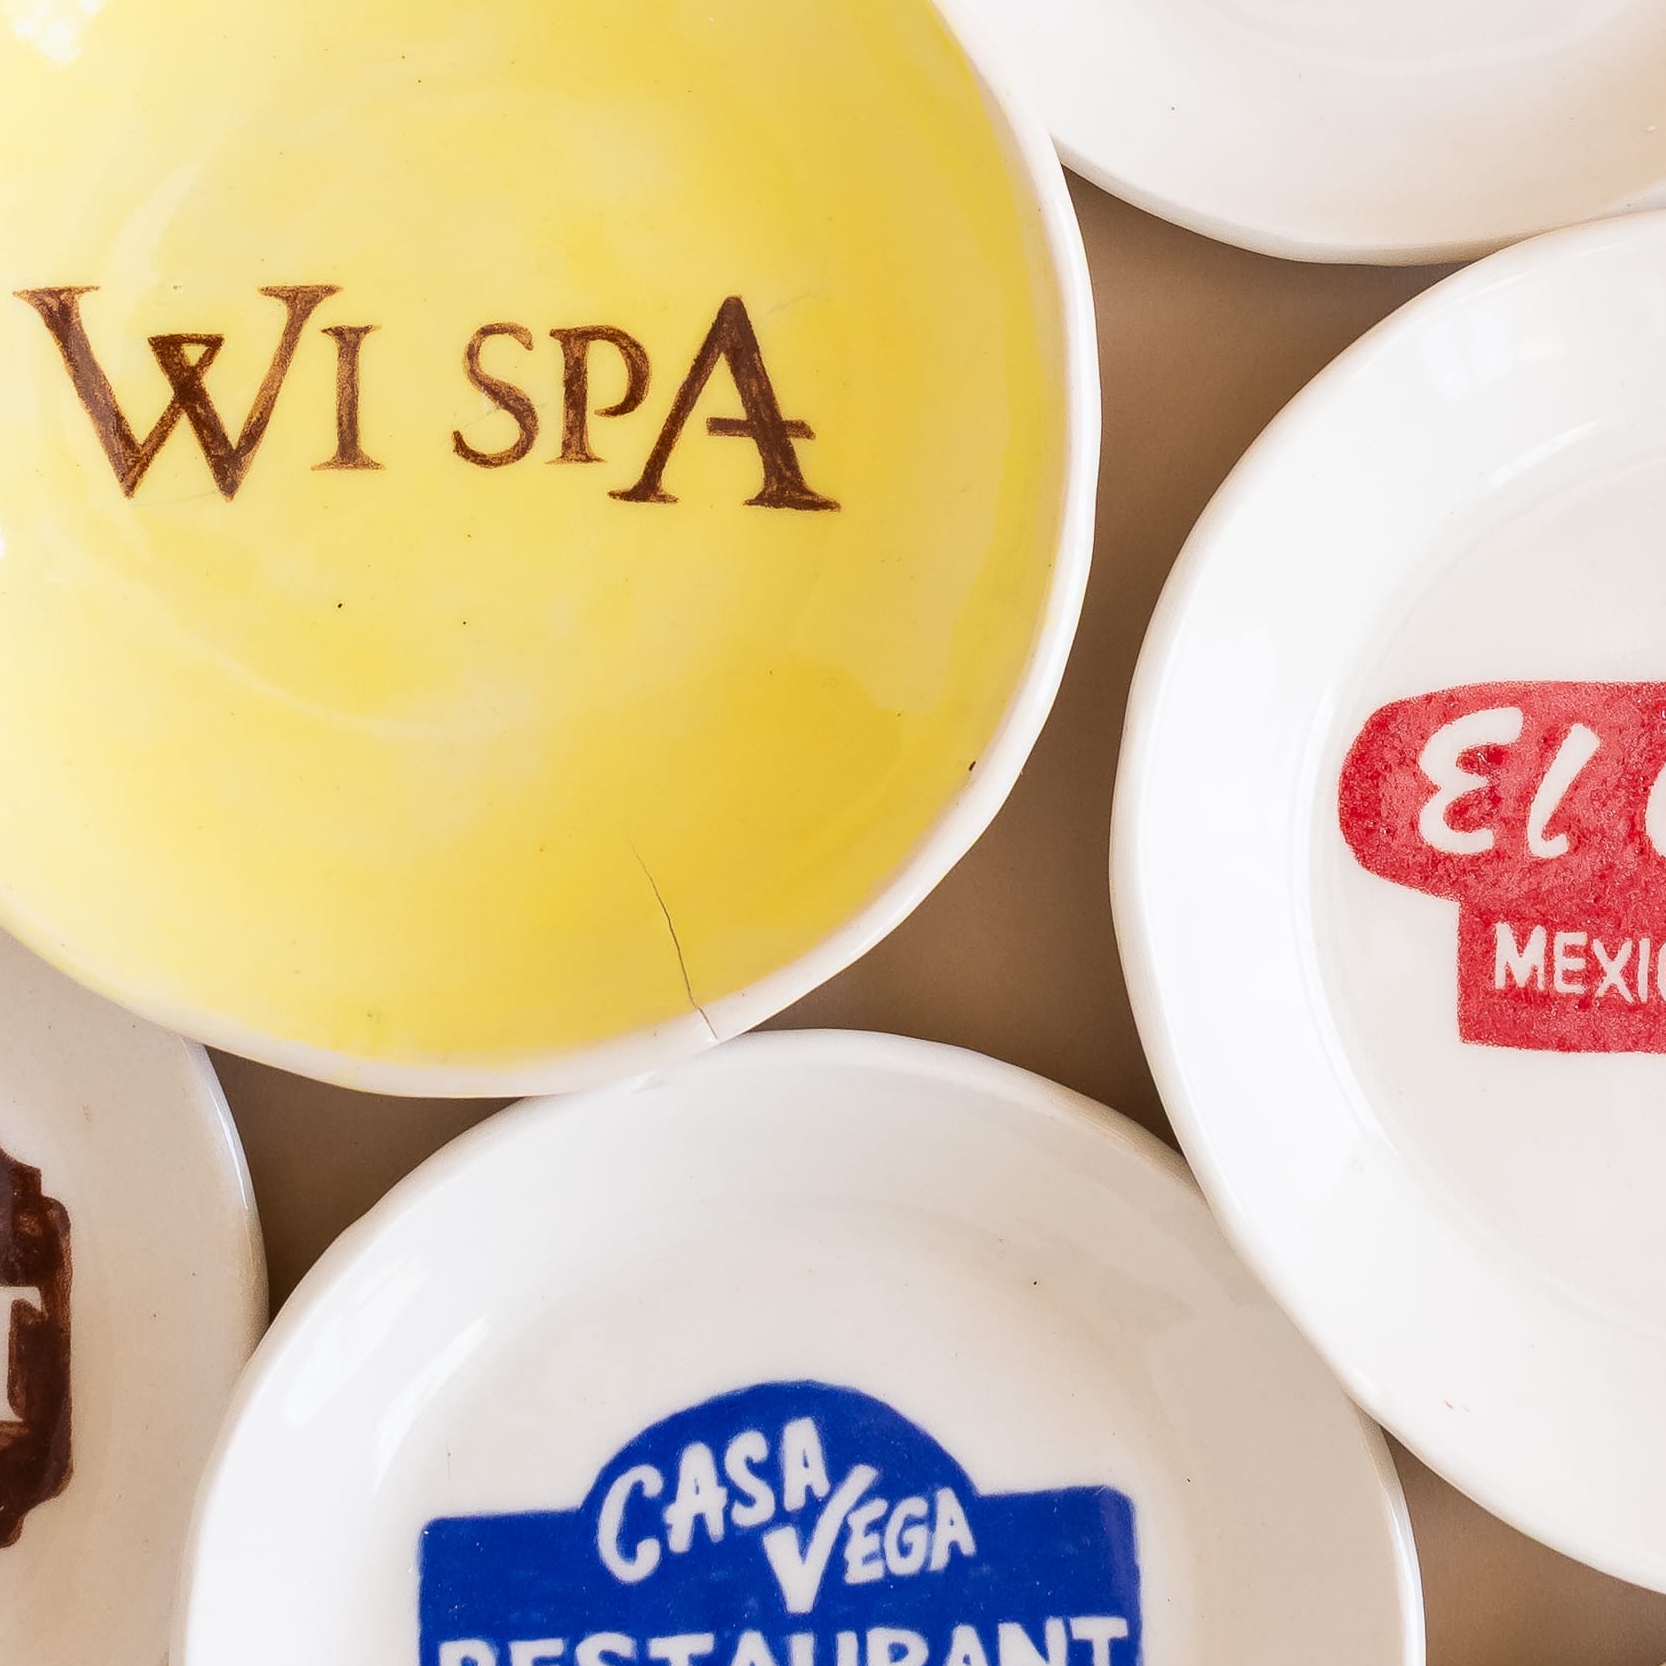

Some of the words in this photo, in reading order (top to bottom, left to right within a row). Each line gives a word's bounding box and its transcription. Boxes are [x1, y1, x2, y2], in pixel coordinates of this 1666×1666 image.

[12, 284, 386, 503] WI
[452, 294, 841, 512] SPA
[1418, 706, 1602, 860] El
[597, 1416, 830, 1584] CASA
[761, 1463, 977, 1614] VEGA
